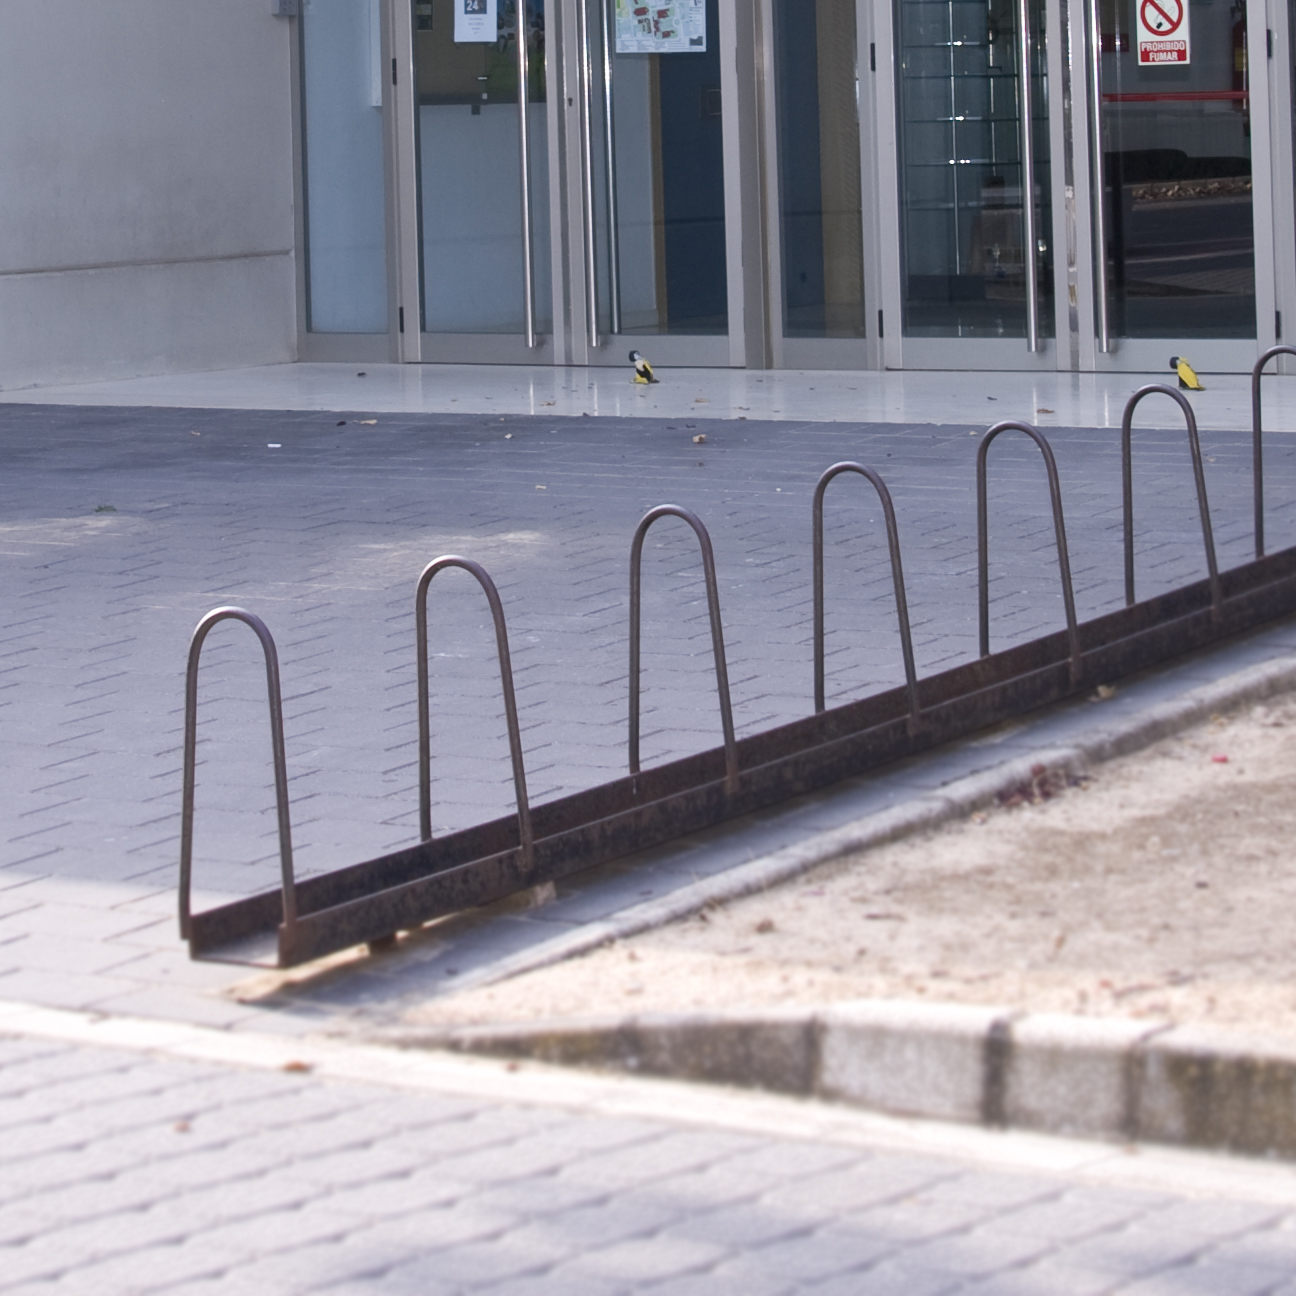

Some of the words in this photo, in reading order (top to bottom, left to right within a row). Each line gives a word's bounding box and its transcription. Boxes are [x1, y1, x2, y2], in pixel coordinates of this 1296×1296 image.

[466, 0, 479, 11] 24
[1141, 41, 1185, 52] PROHIBIDO
[1149, 51, 1178, 62] FUMAR
